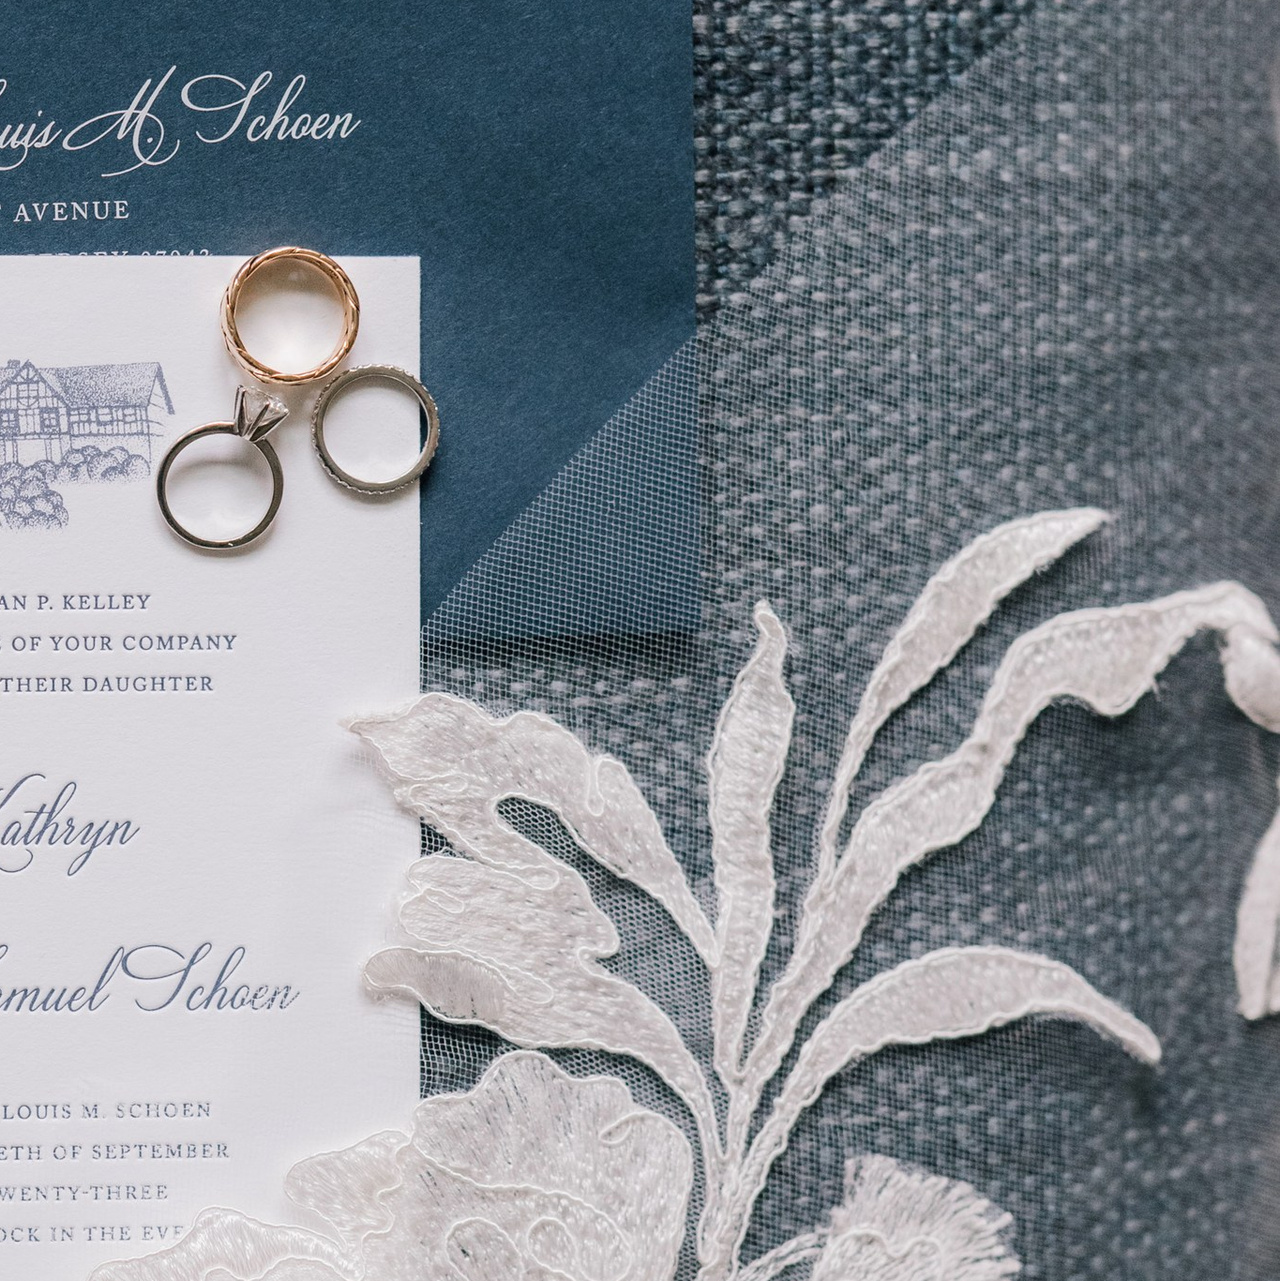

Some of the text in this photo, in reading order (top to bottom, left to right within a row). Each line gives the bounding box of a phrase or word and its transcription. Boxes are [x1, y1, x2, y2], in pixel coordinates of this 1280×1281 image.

[61, 65, 181, 178] M.
[180, 72, 363, 145] Schoen
[12, 200, 130, 223] AVENUE
[36, 594, 54, 611] P.
[62, 594, 151, 610] KELLEY
[11, 635, 42, 652] OF
[49, 635, 113, 652] YOUR
[122, 634, 238, 651] COMPANY
[0, 676, 74, 693] THEIR
[82, 675, 214, 692] DAUGHTER
[120, 941, 300, 1014] Schoen
[2, 1103, 72, 1120] LOUIS
[80, 1102, 107, 1120] M.
[115, 1102, 210, 1119] SCHOEN
[52, 1144, 83, 1161] OF
[91, 1143, 230, 1160] SEPTEMBER
[49, 1226, 75, 1242] IN
[82, 1225, 131, 1242] THE
